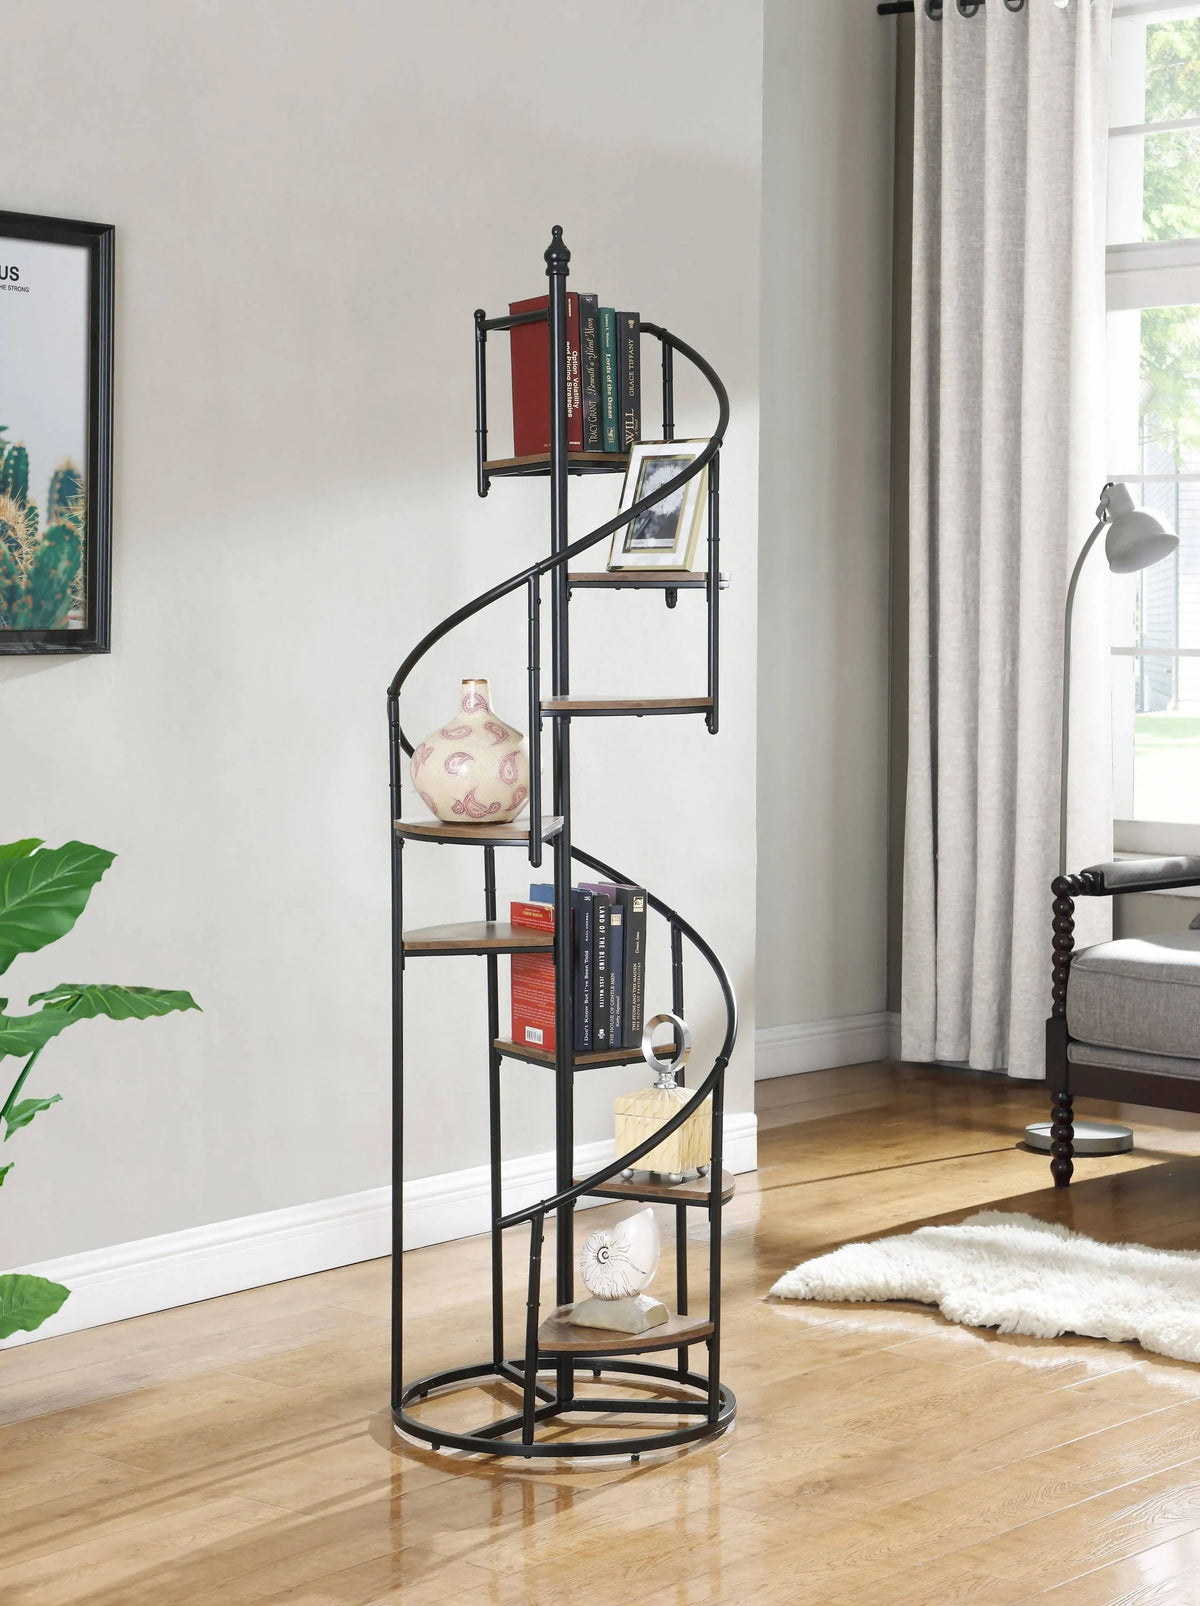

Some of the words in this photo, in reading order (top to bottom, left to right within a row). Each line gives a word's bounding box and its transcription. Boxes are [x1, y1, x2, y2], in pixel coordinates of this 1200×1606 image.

[585, 318, 594, 339] Moon
[586, 364, 597, 396] Beneath
[572, 378, 580, 408] Volatility
[588, 400, 597, 422] GRANT
[588, 423, 598, 444] TRACY
[625, 408, 634, 444] WILL
[599, 925, 605, 933] OF
